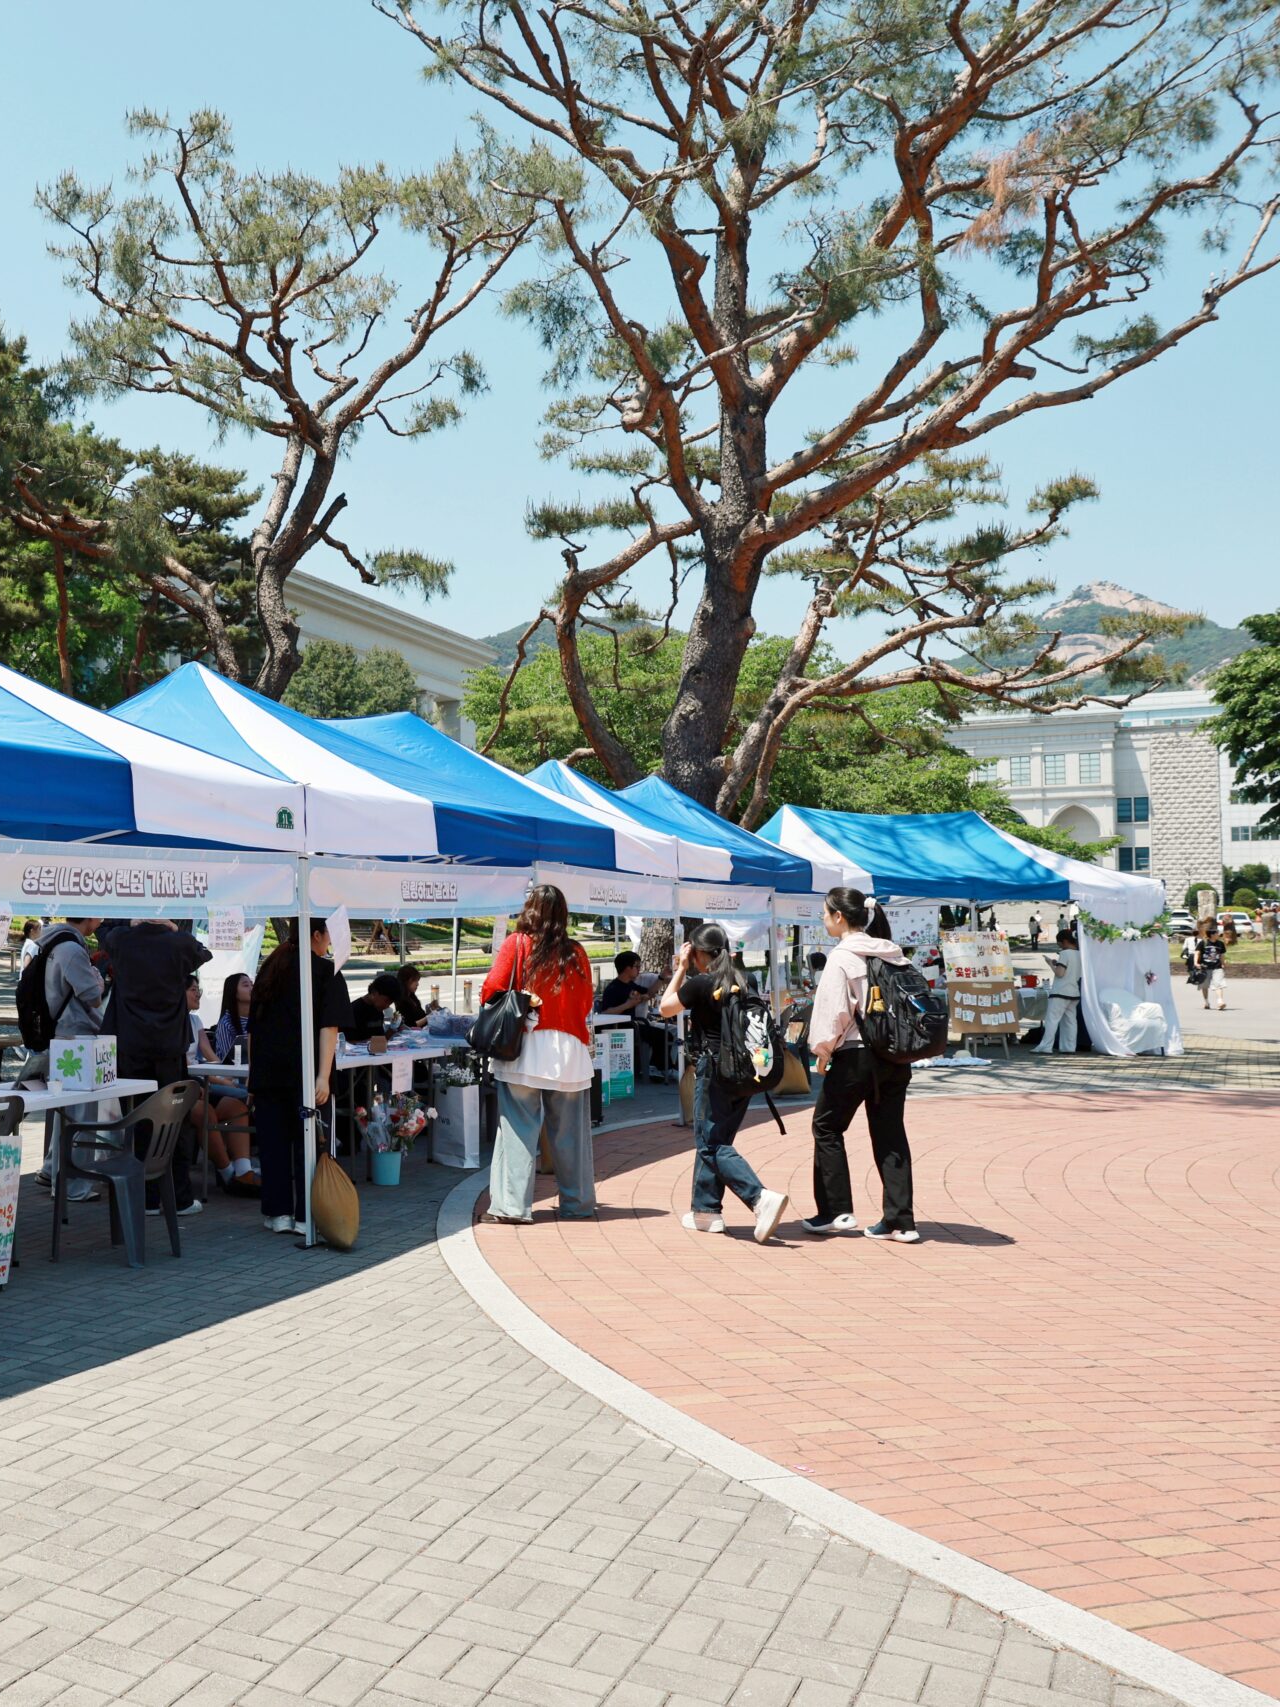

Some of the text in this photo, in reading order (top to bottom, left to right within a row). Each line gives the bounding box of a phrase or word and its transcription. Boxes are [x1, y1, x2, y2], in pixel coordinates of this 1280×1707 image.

[22, 865, 57, 895] 영문
[57, 867, 112, 896] LEGO:
[116, 869, 145, 897] 랜덤
[401, 880, 458, 902] 힐링하고 갈래요
[590, 883, 608, 905] Lucky
[95, 1047, 113, 1066] Lucky
